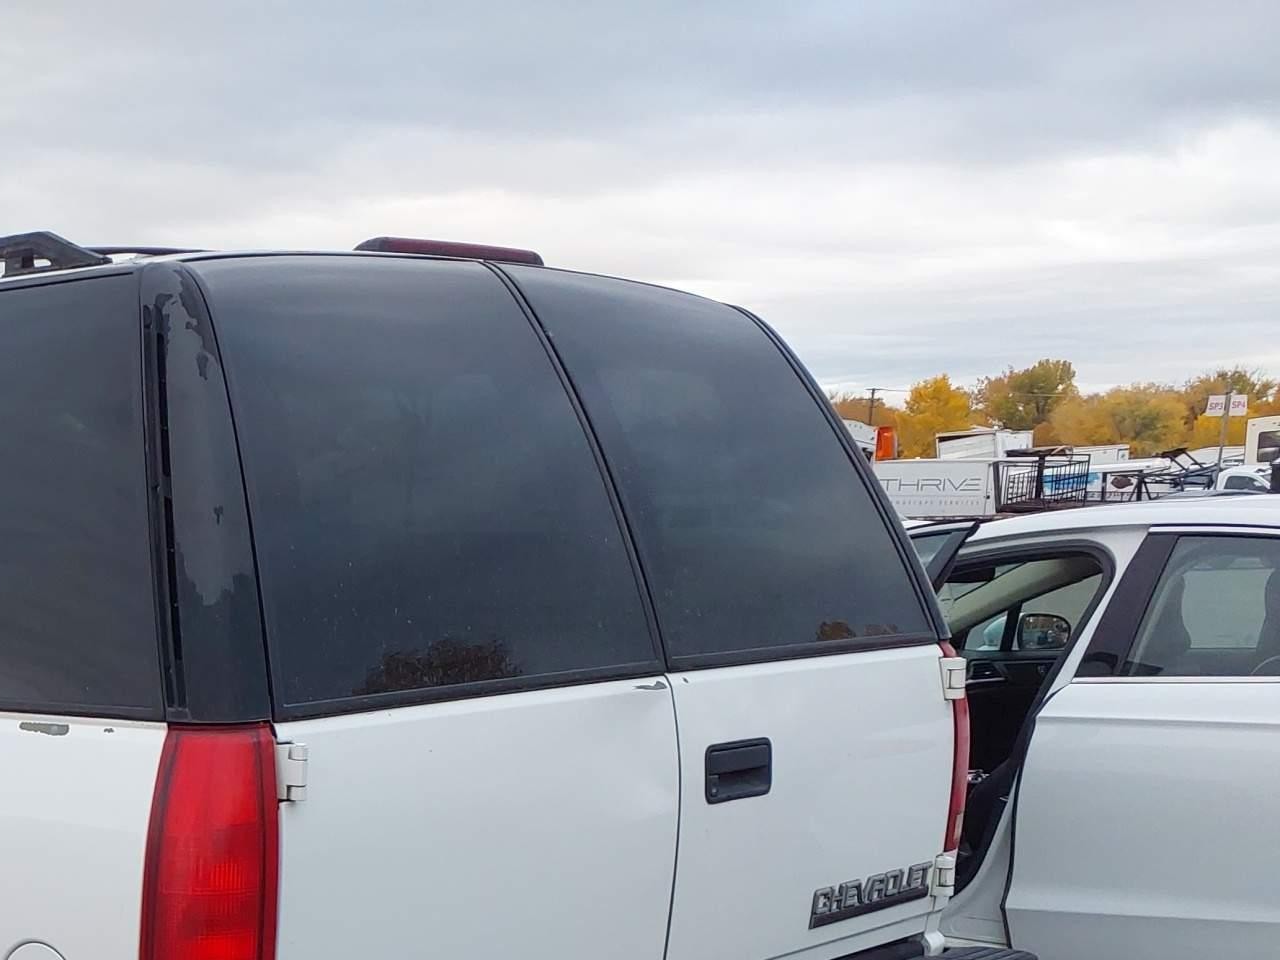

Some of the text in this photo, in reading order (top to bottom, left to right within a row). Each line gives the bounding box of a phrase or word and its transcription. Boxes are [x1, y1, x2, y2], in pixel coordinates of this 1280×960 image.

[1231, 400, 1246, 409] SP4
[878, 478, 981, 491] THRIVE
[813, 861, 933, 914] CHEVROLET
